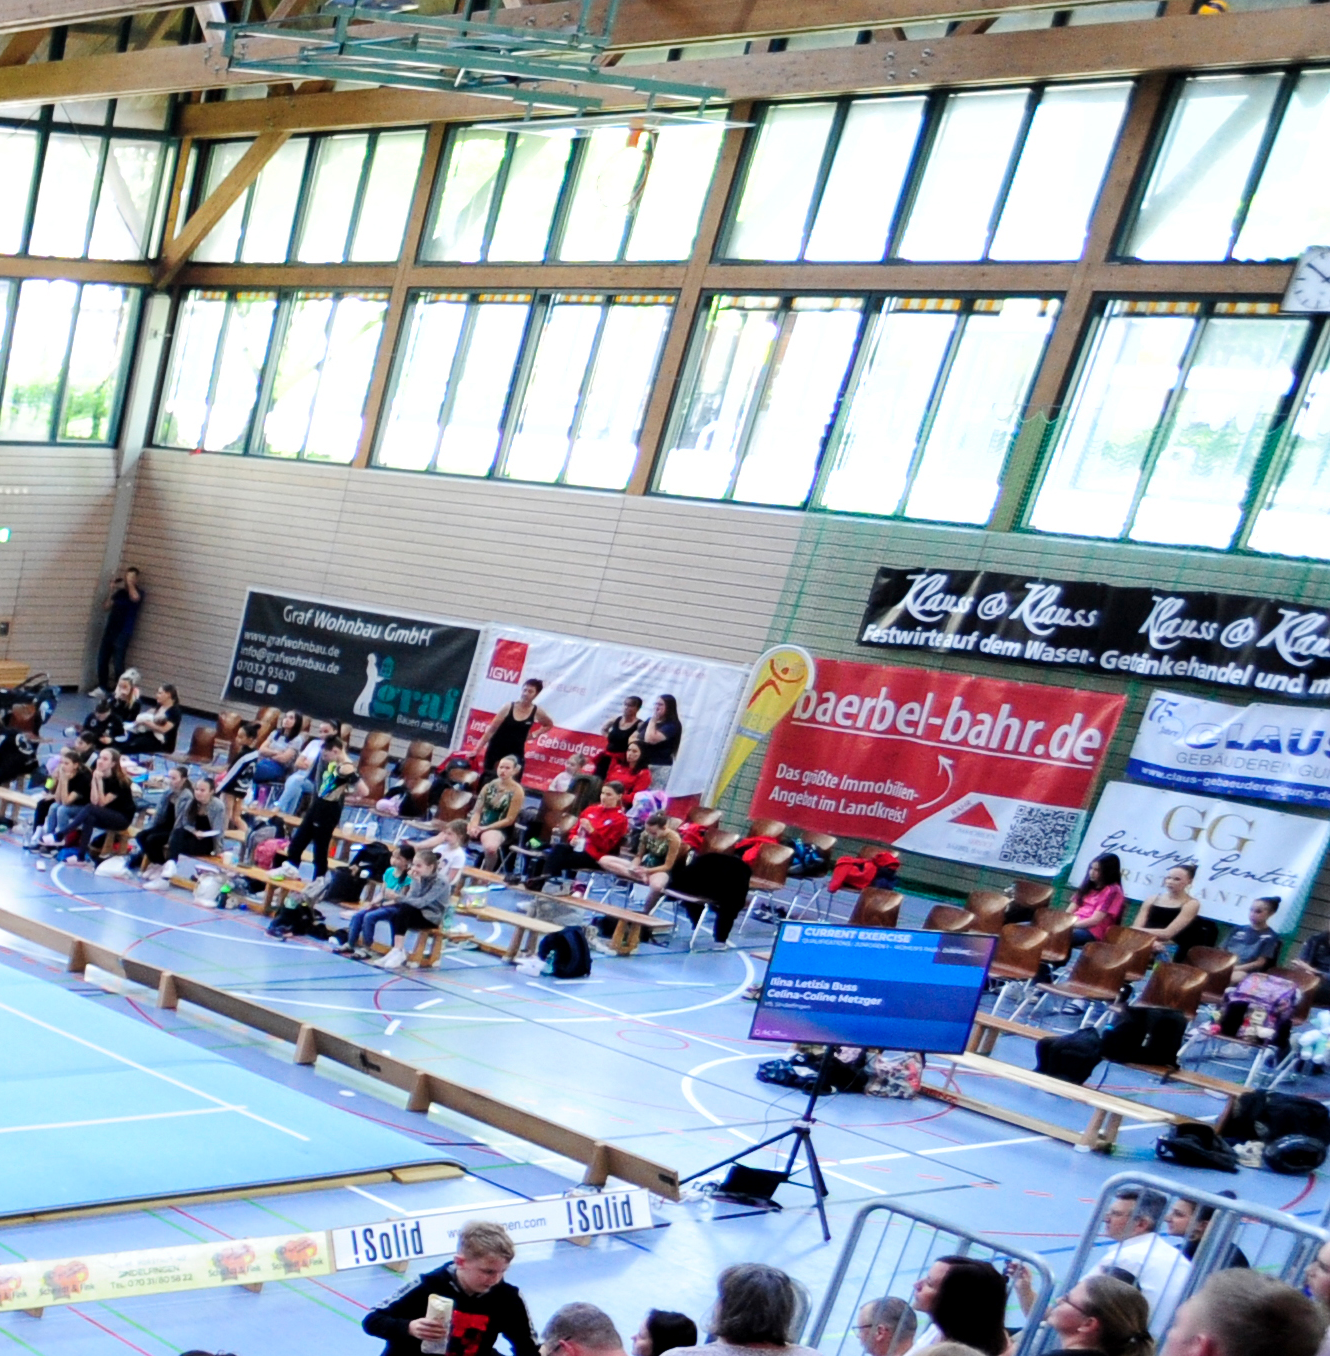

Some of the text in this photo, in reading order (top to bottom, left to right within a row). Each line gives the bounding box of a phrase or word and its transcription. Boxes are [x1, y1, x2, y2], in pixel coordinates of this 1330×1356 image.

[897, 573, 974, 622] Klauss
[1009, 583, 1099, 636] Klauss
[283, 605, 433, 647] Graf Wohnbau GmbH
[1138, 595, 1219, 650] Klauss
[1256, 608, 1330, 667] Klau
[243, 630, 340, 658] www.grafwohnbau.de
[236, 660, 266, 676] 07032
[240, 644, 340, 675] info@grafwohnbau.de
[942, 631, 980, 650] auf
[979, 634, 1022, 657] dem
[1254, 671, 1305, 694] und
[489, 666, 520, 684] IGW
[396, 714, 420, 729] Bauen
[1148, 697, 1179, 724] 75
[792, 686, 1102, 763] baerbel-bahr.de
[775, 763, 800, 780] Das
[801, 768, 839, 789] größte
[768, 786, 818, 810] Angebot
[818, 795, 837, 811] im
[804, 927, 912, 944] CURRENT EXERCISE
[767, 988, 883, 1007] Celina-Coline Metzger
[795, 979, 830, 991] Letizia
[832, 982, 858, 992] Buss
[566, 1194, 633, 1235] !Solid
[350, 1220, 425, 1264] !Solid
